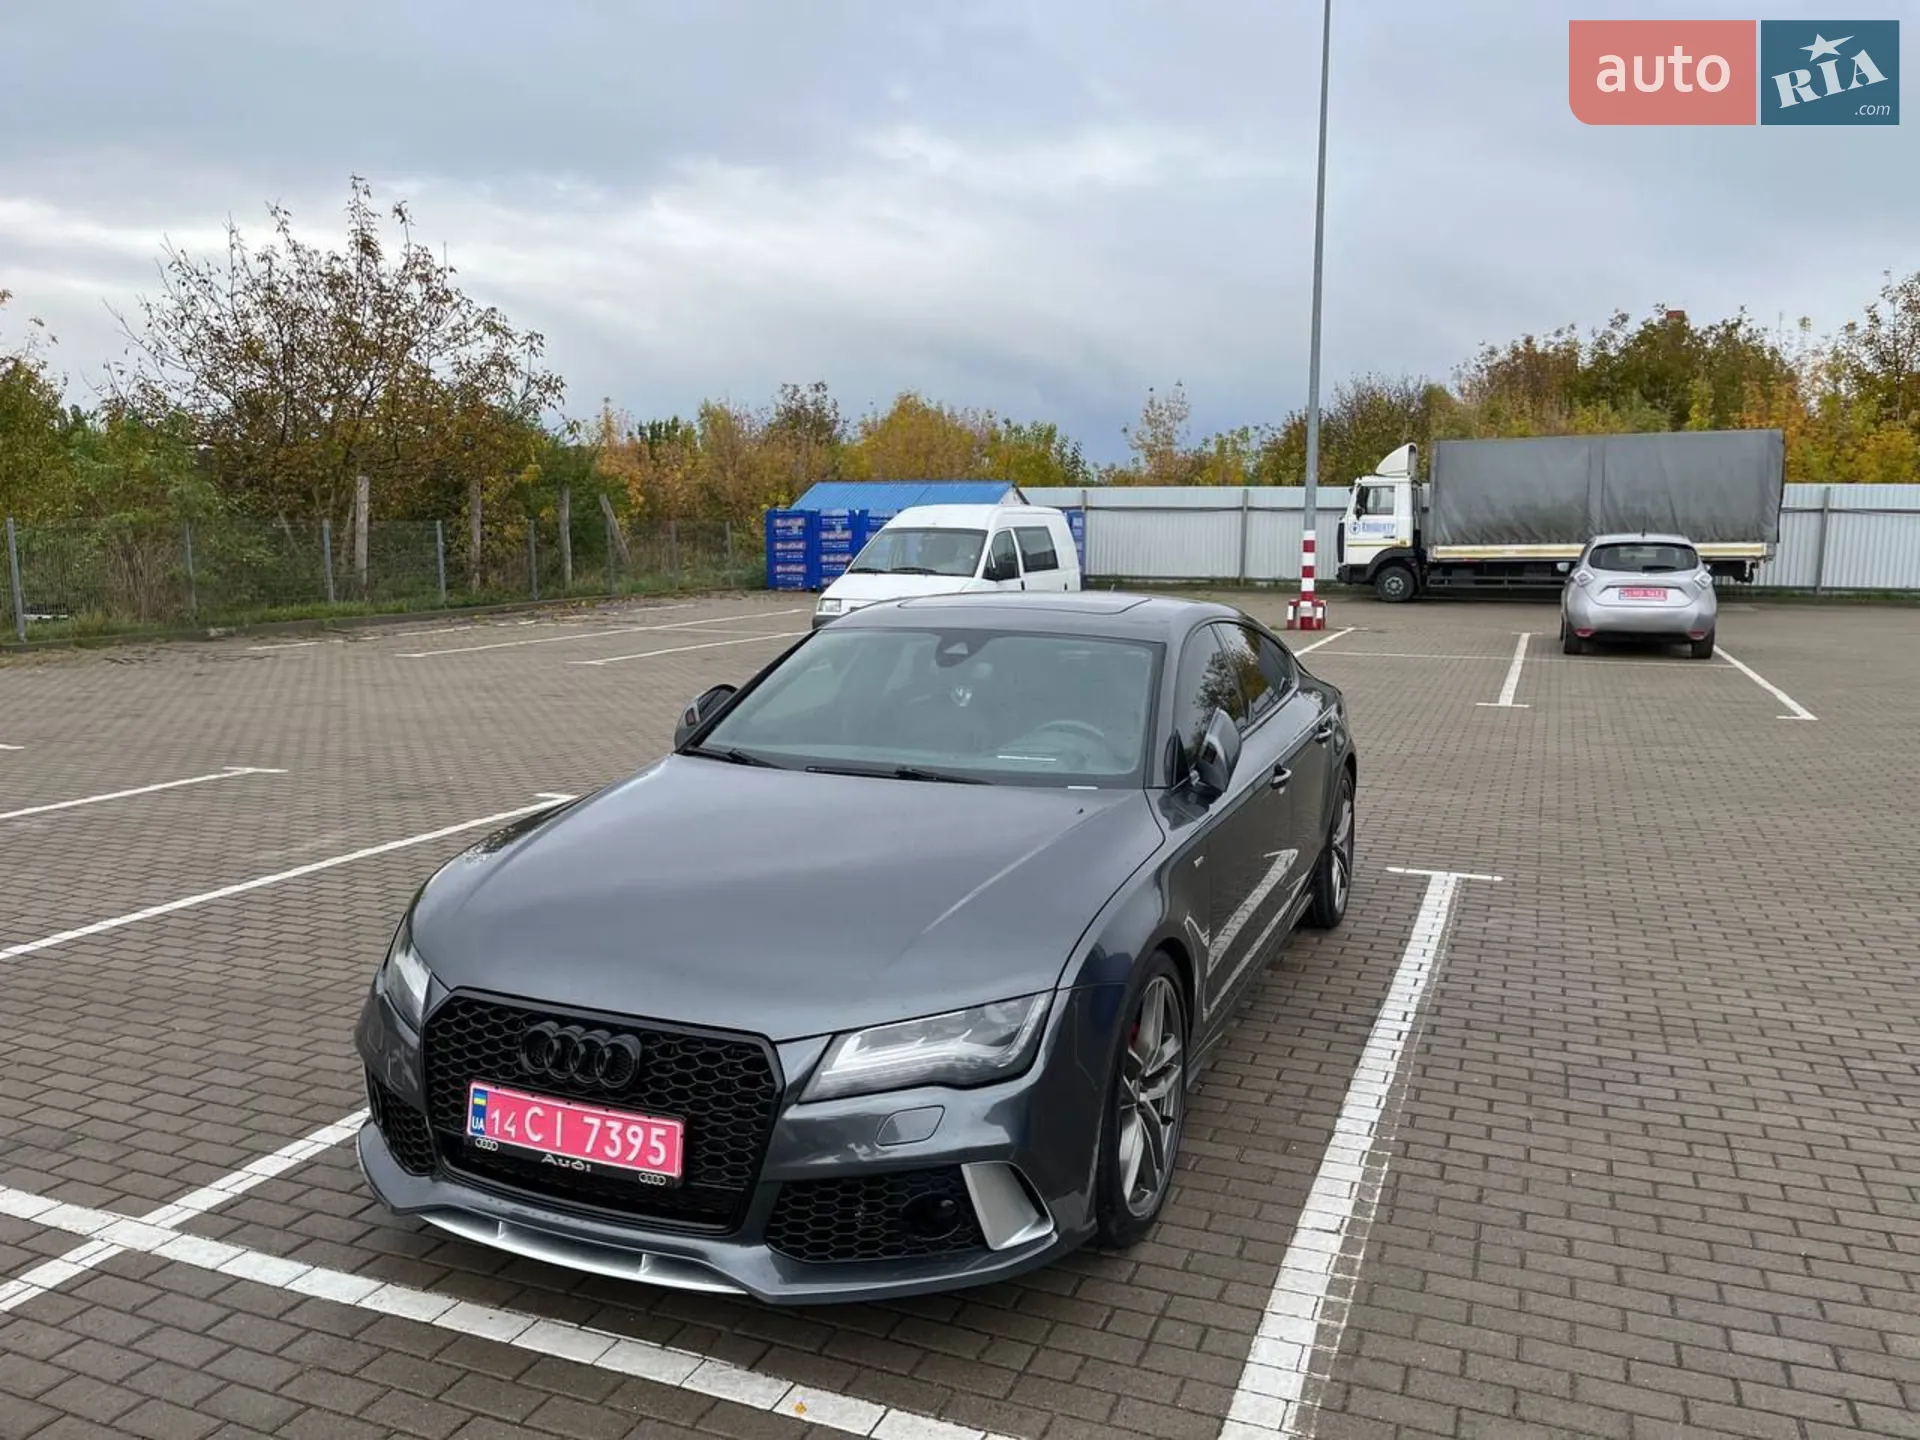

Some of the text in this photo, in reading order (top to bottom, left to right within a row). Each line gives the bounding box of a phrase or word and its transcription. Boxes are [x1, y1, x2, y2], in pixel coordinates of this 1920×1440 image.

[471, 1115, 485, 1131] UA
[582, 1115, 667, 1167] 7395
[540, 1151, 592, 1173] Audi
